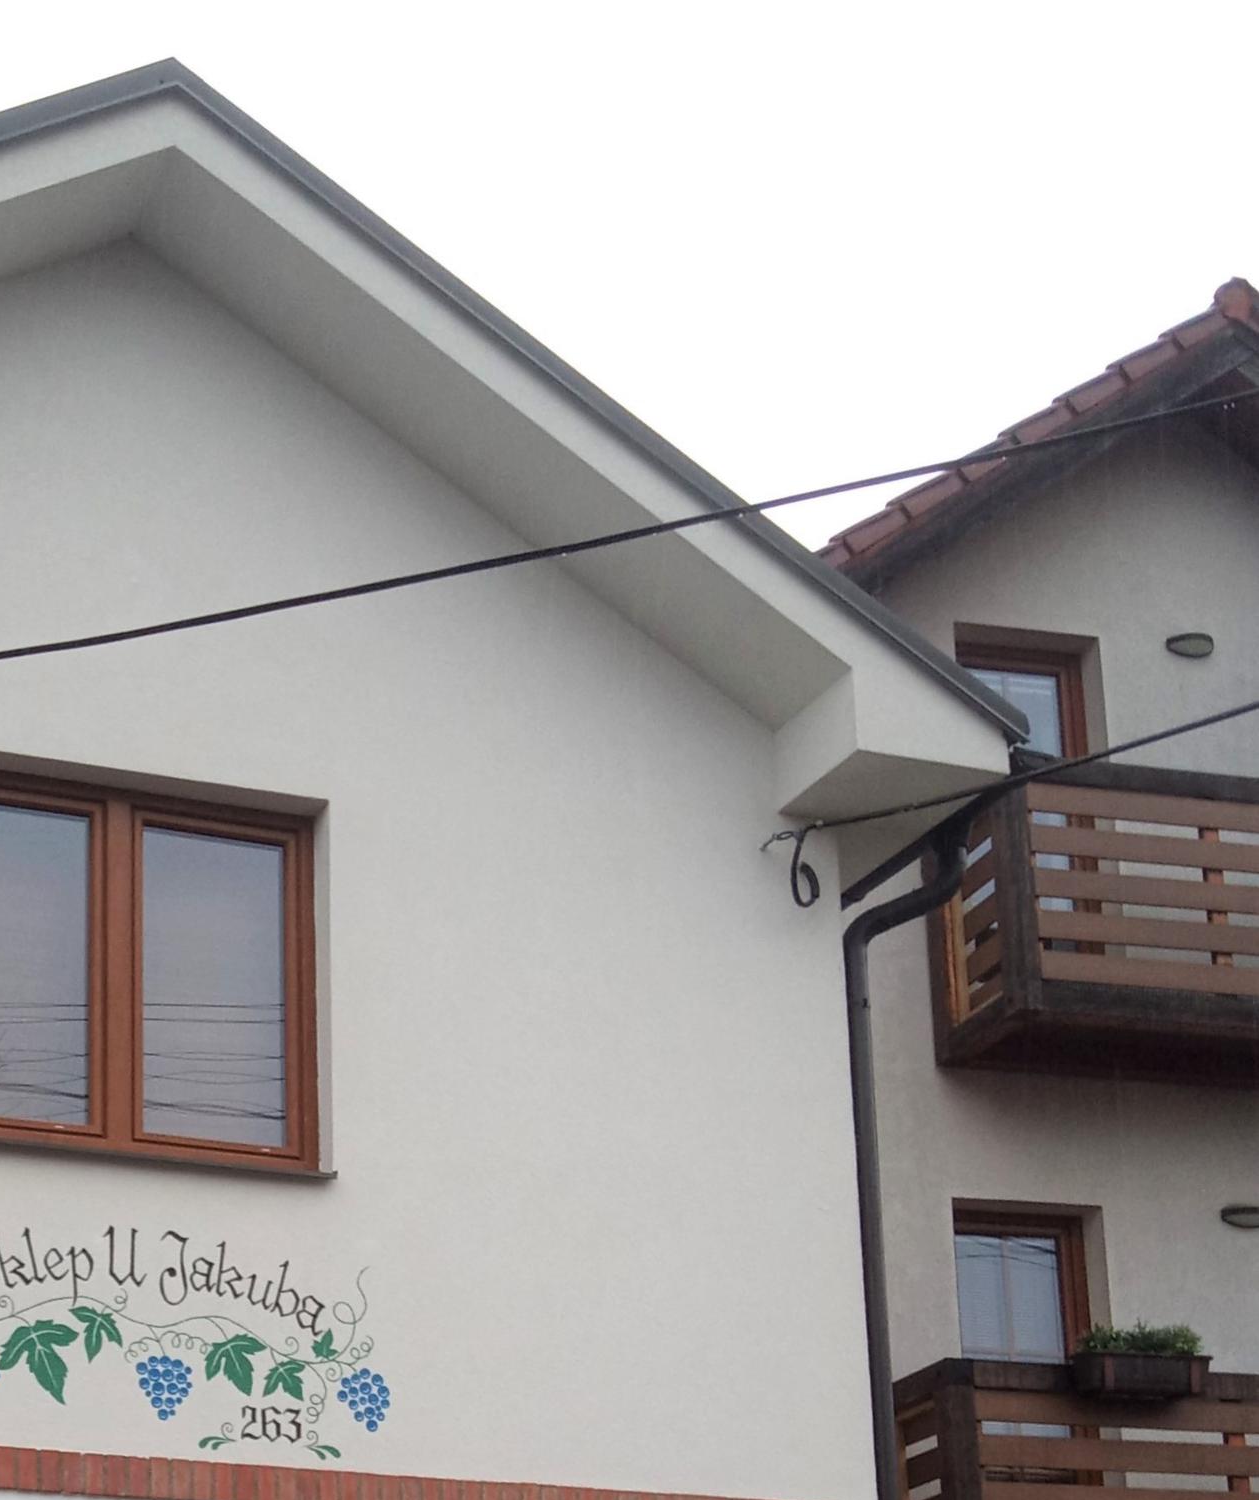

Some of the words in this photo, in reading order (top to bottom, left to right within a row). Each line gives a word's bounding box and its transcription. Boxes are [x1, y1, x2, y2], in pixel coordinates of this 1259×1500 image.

[103, 1225, 147, 1287] U
[159, 1230, 328, 1336] Jakuba
[240, 1405, 303, 1444] 263
